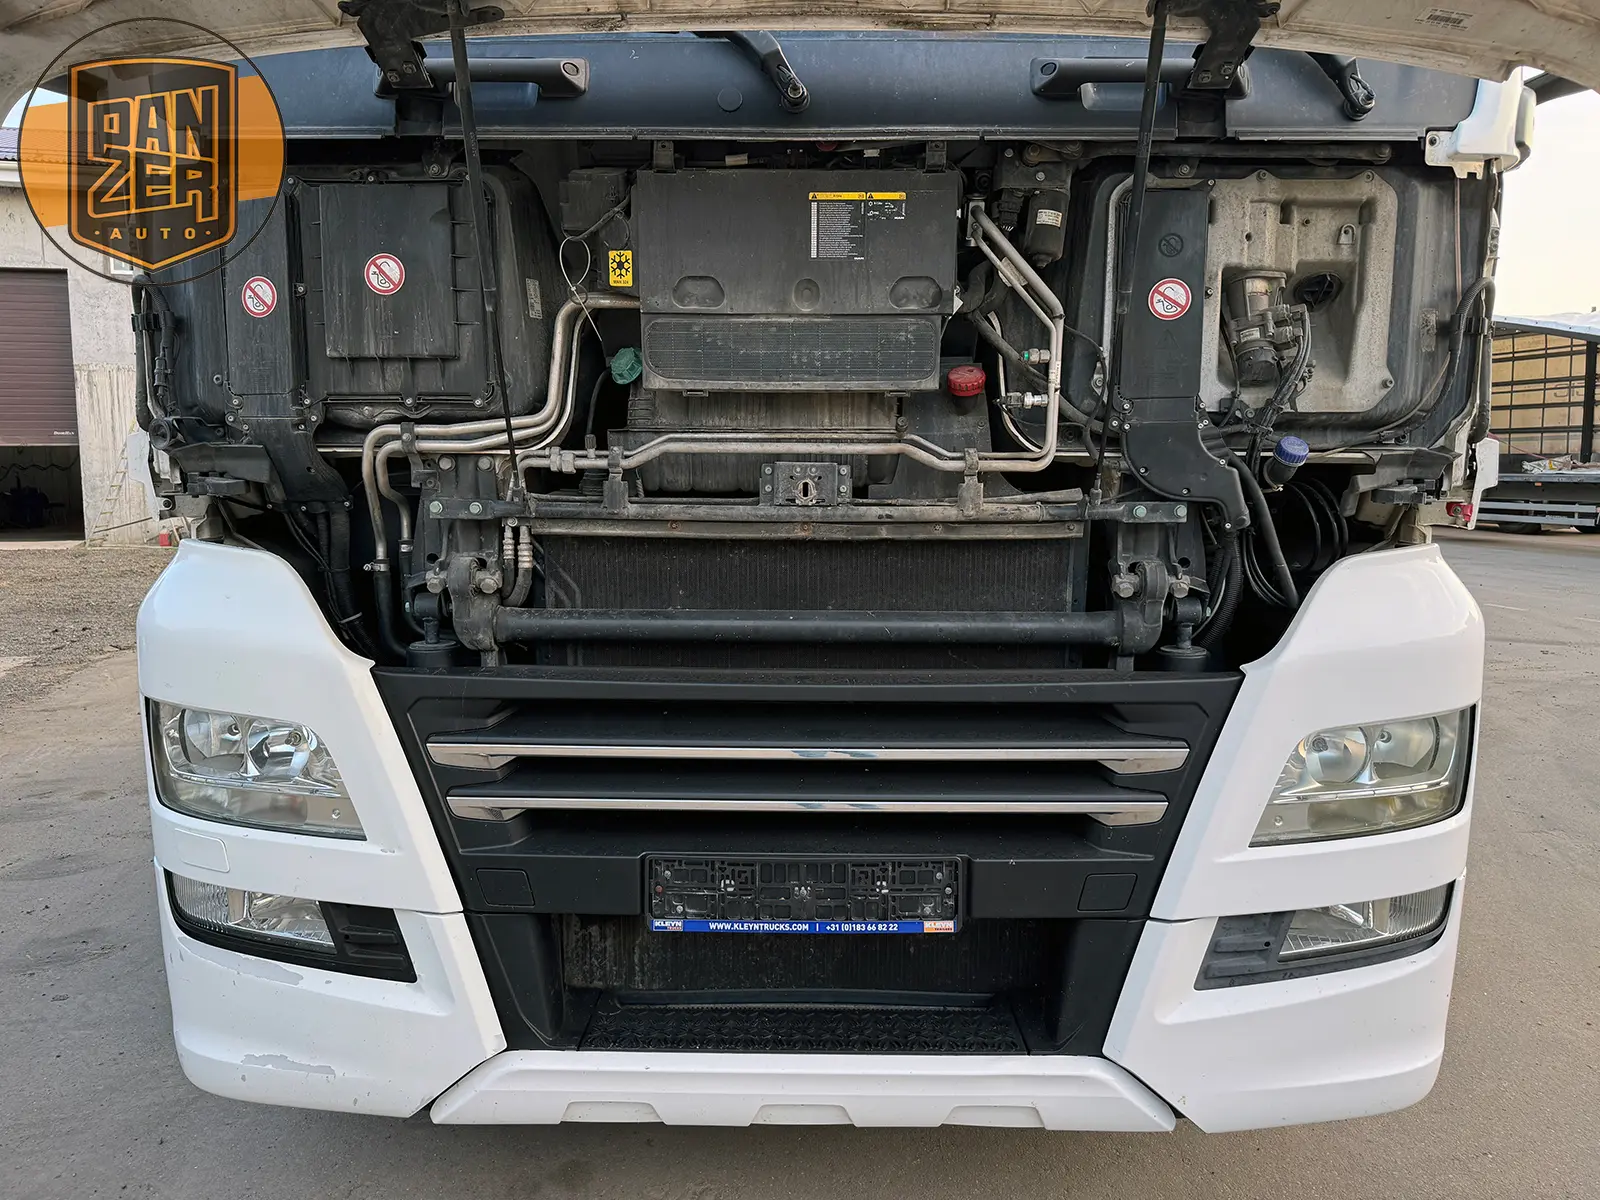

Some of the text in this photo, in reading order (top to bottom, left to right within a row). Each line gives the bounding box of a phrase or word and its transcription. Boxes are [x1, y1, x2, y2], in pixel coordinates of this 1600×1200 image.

[709, 922, 898, 932] WWW.KLEYNTRUCKS.COM +31 (0)183 66 82 22
